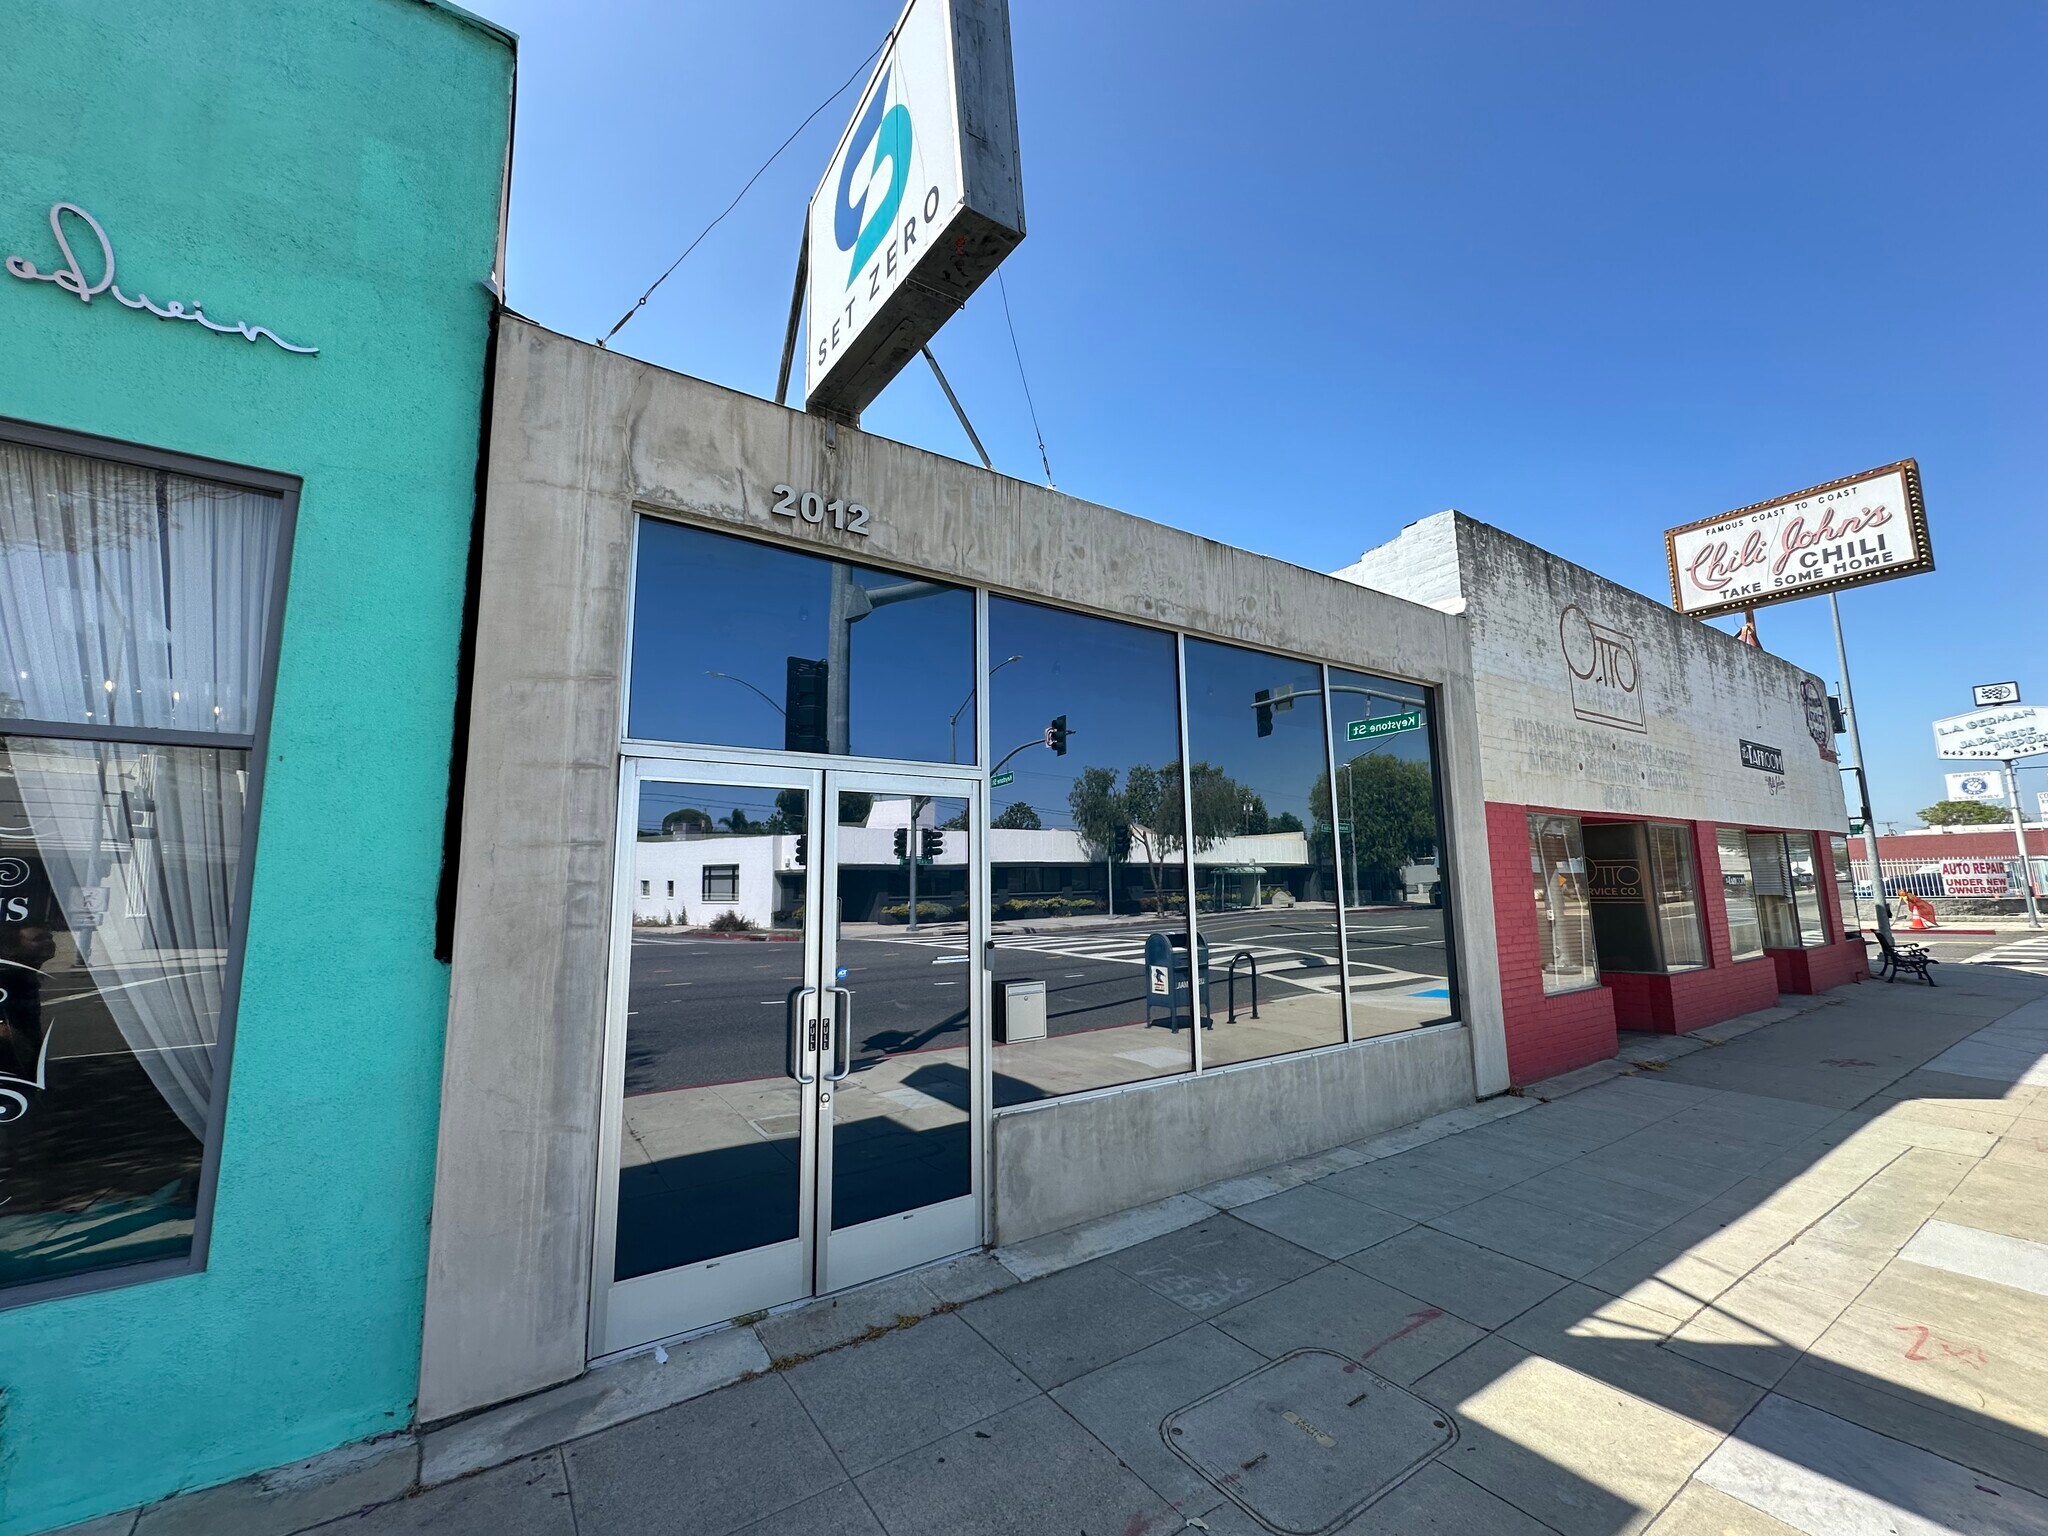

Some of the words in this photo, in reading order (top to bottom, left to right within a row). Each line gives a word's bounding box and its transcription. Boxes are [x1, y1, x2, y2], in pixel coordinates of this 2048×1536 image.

[818, 298, 857, 367] SET
[869, 185, 939, 297] ZERO
[771, 484, 870, 536] 2012
[1706, 520, 1743, 536] FAMOUS
[1751, 508, 1785, 523] COAST
[1795, 501, 1808, 511] TO
[1818, 487, 1857, 503] COAST
[1685, 529, 1767, 591] Chili
[1772, 506, 1892, 575] John's
[1800, 533, 1887, 568] CHILI
[1719, 582, 1762, 600] TAKE
[1774, 567, 1824, 588] SOME
[1834, 551, 1894, 575] HOME
[1966, 708, 2036, 729] GERMAN
[1960, 727, 2037, 749] JAPANESE
[1943, 863, 1970, 875] AUTO
[1972, 862, 2006, 874] REPAIR
[1946, 878, 1983, 886] UNDER
[1986, 878, 2006, 886] NEW
[1588, 887, 1618, 896] RVICE
[1620, 887, 1639, 896] CO.
